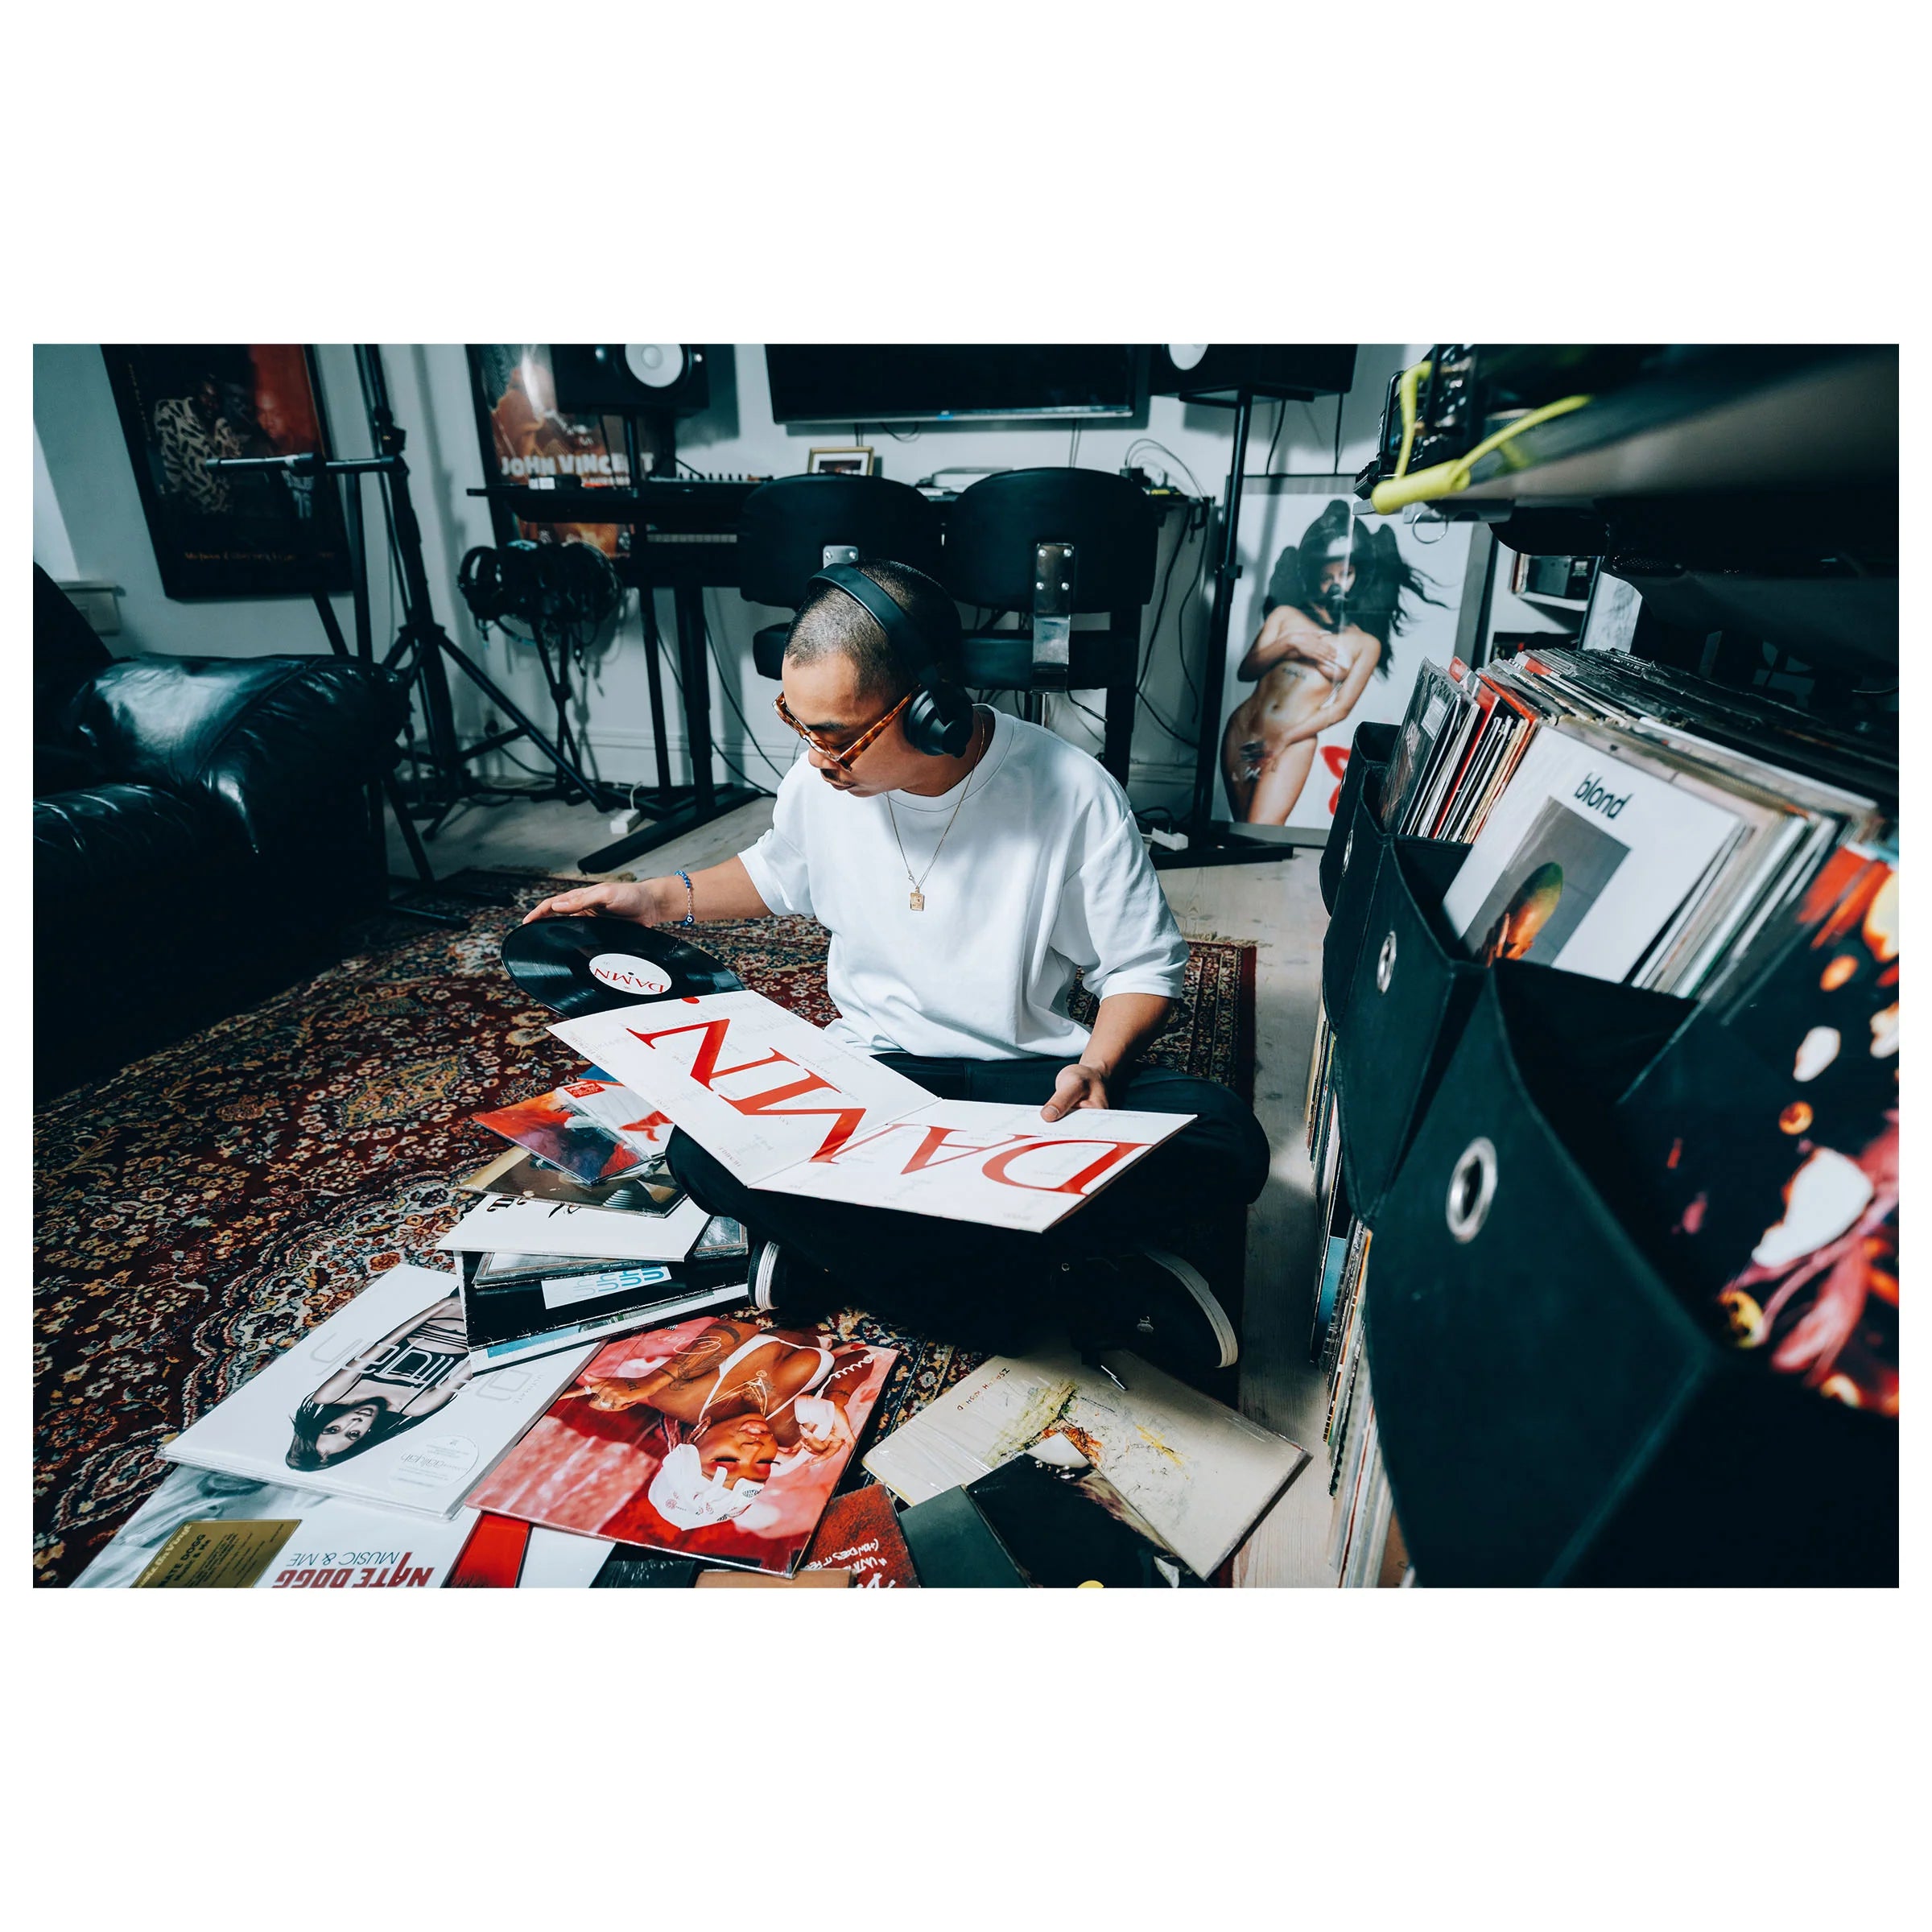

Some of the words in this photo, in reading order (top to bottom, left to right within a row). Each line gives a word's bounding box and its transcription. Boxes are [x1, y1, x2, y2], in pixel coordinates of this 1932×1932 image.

[501, 455, 557, 477] JOHN
[1573, 773, 1633, 819] blond
[286, 1553, 320, 1567] ME
[322, 1552, 337, 1567] &
[336, 1550, 400, 1567] MUSIC
[359, 1550, 436, 1587] NATE
[272, 1567, 356, 1587] DOGG
